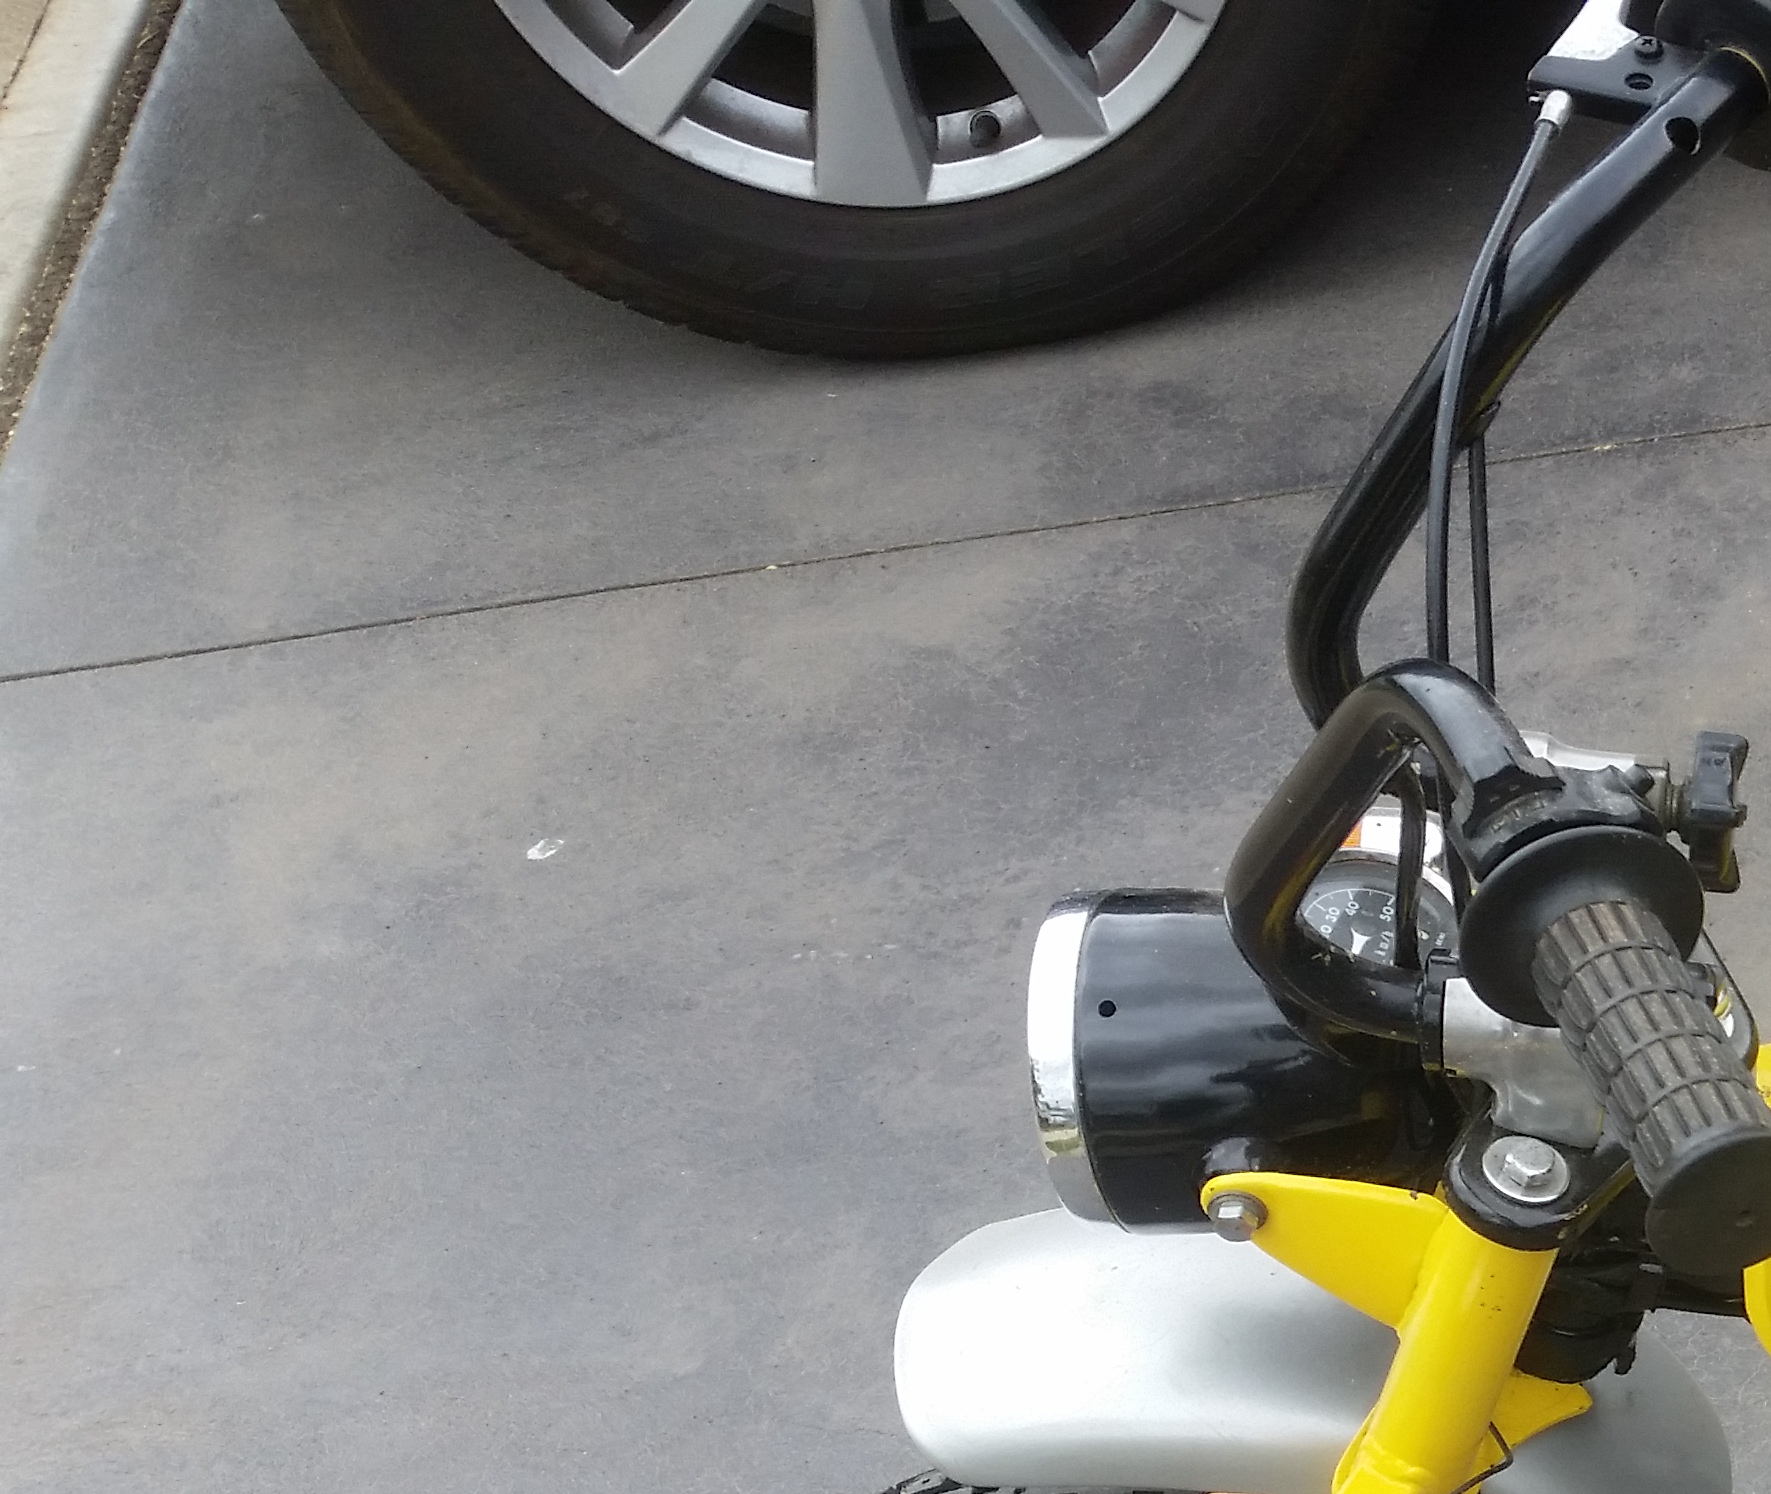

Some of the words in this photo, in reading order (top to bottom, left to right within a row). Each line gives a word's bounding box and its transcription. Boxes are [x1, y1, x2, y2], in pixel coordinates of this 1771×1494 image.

[1325, 907, 1340, 923] 30
[1344, 901, 1360, 916] 40
[1379, 906, 1395, 922] 50
[1320, 925, 1332, 938] 0
